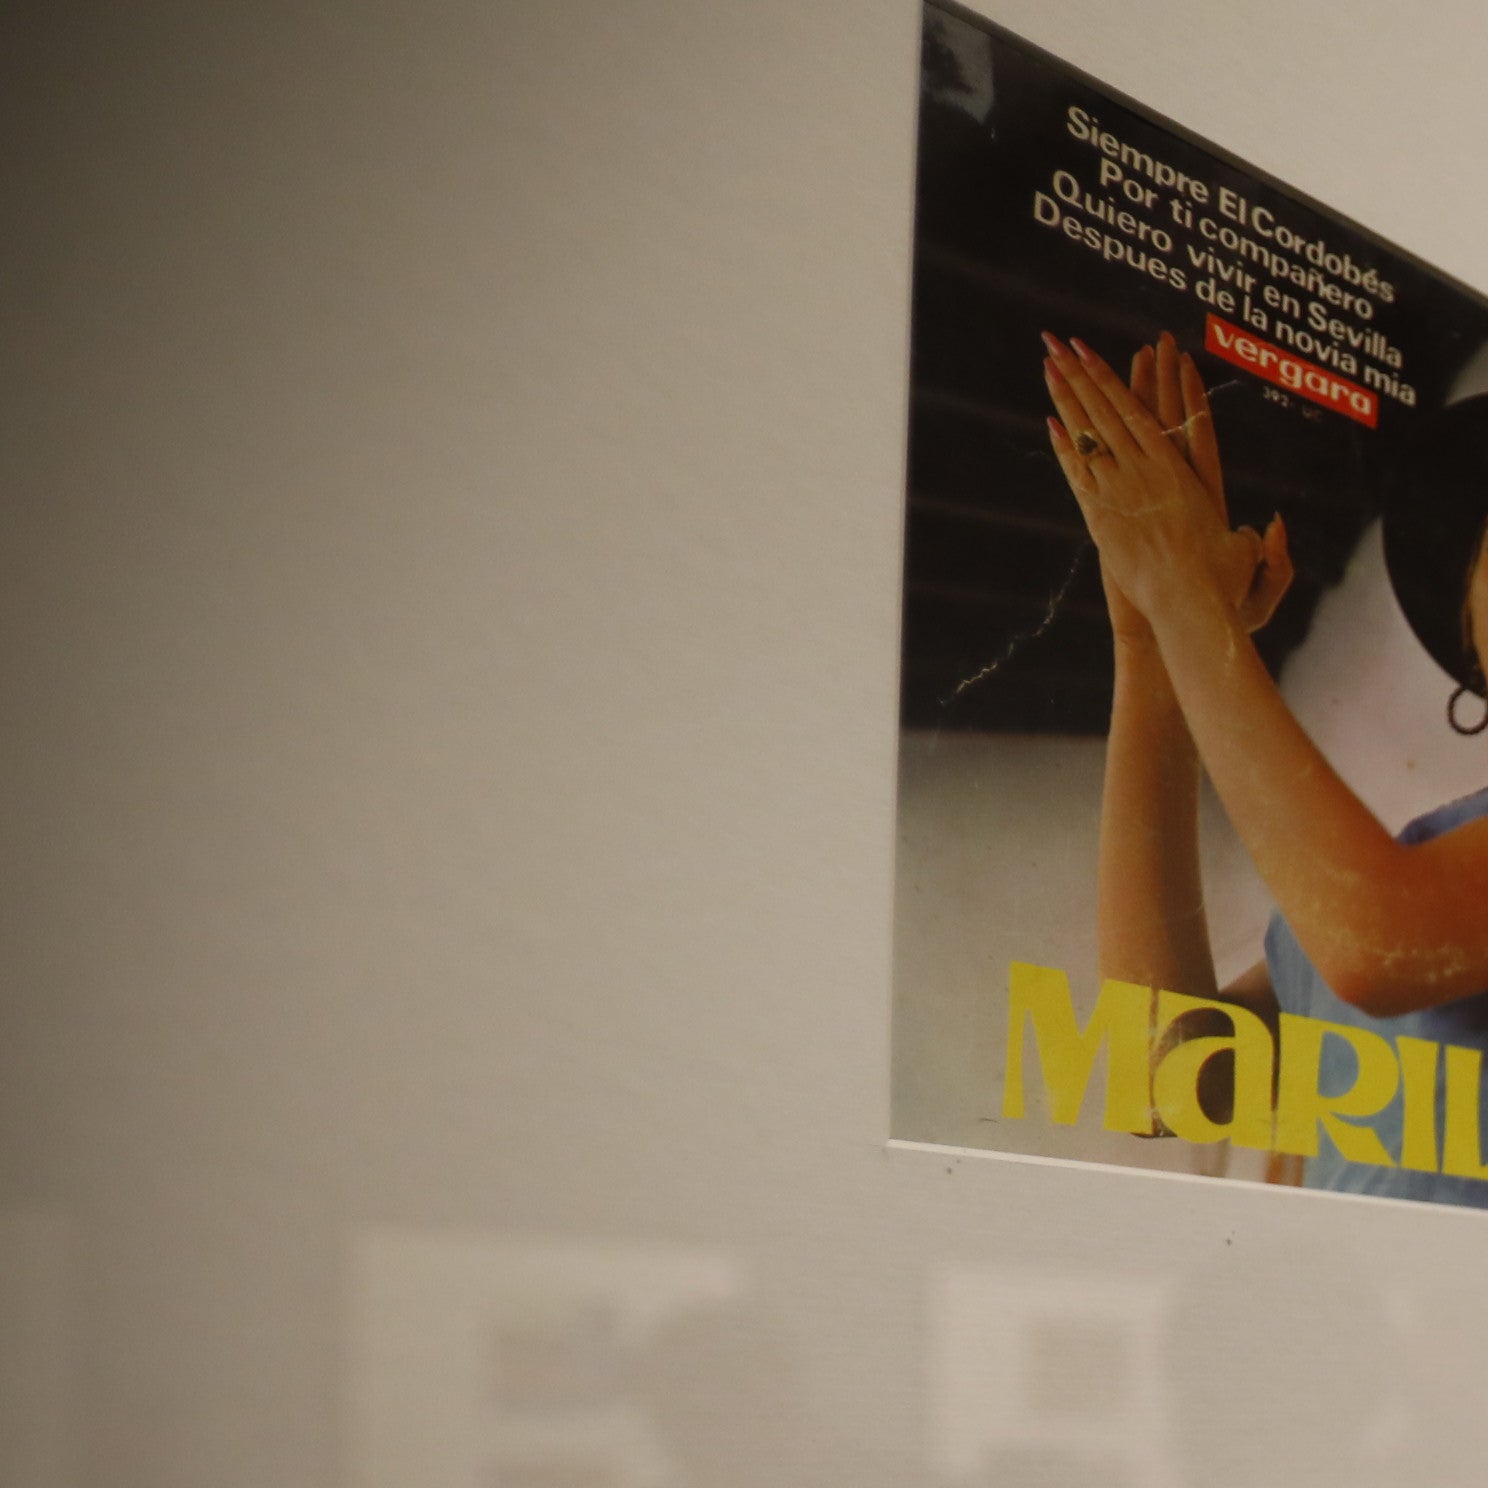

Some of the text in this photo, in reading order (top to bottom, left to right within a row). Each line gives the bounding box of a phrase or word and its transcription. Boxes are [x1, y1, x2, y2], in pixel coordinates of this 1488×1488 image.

[1034, 190, 1416, 406] Despues de la novia mia
[1053, 170, 1402, 368] Quiero vivir en Sevilla
[1067, 106, 1209, 203] Siempre
[1252, 206, 1395, 303] Cordobés
[1100, 157, 1373, 320] Por ti compañero
[1212, 323, 1371, 415] vergara
